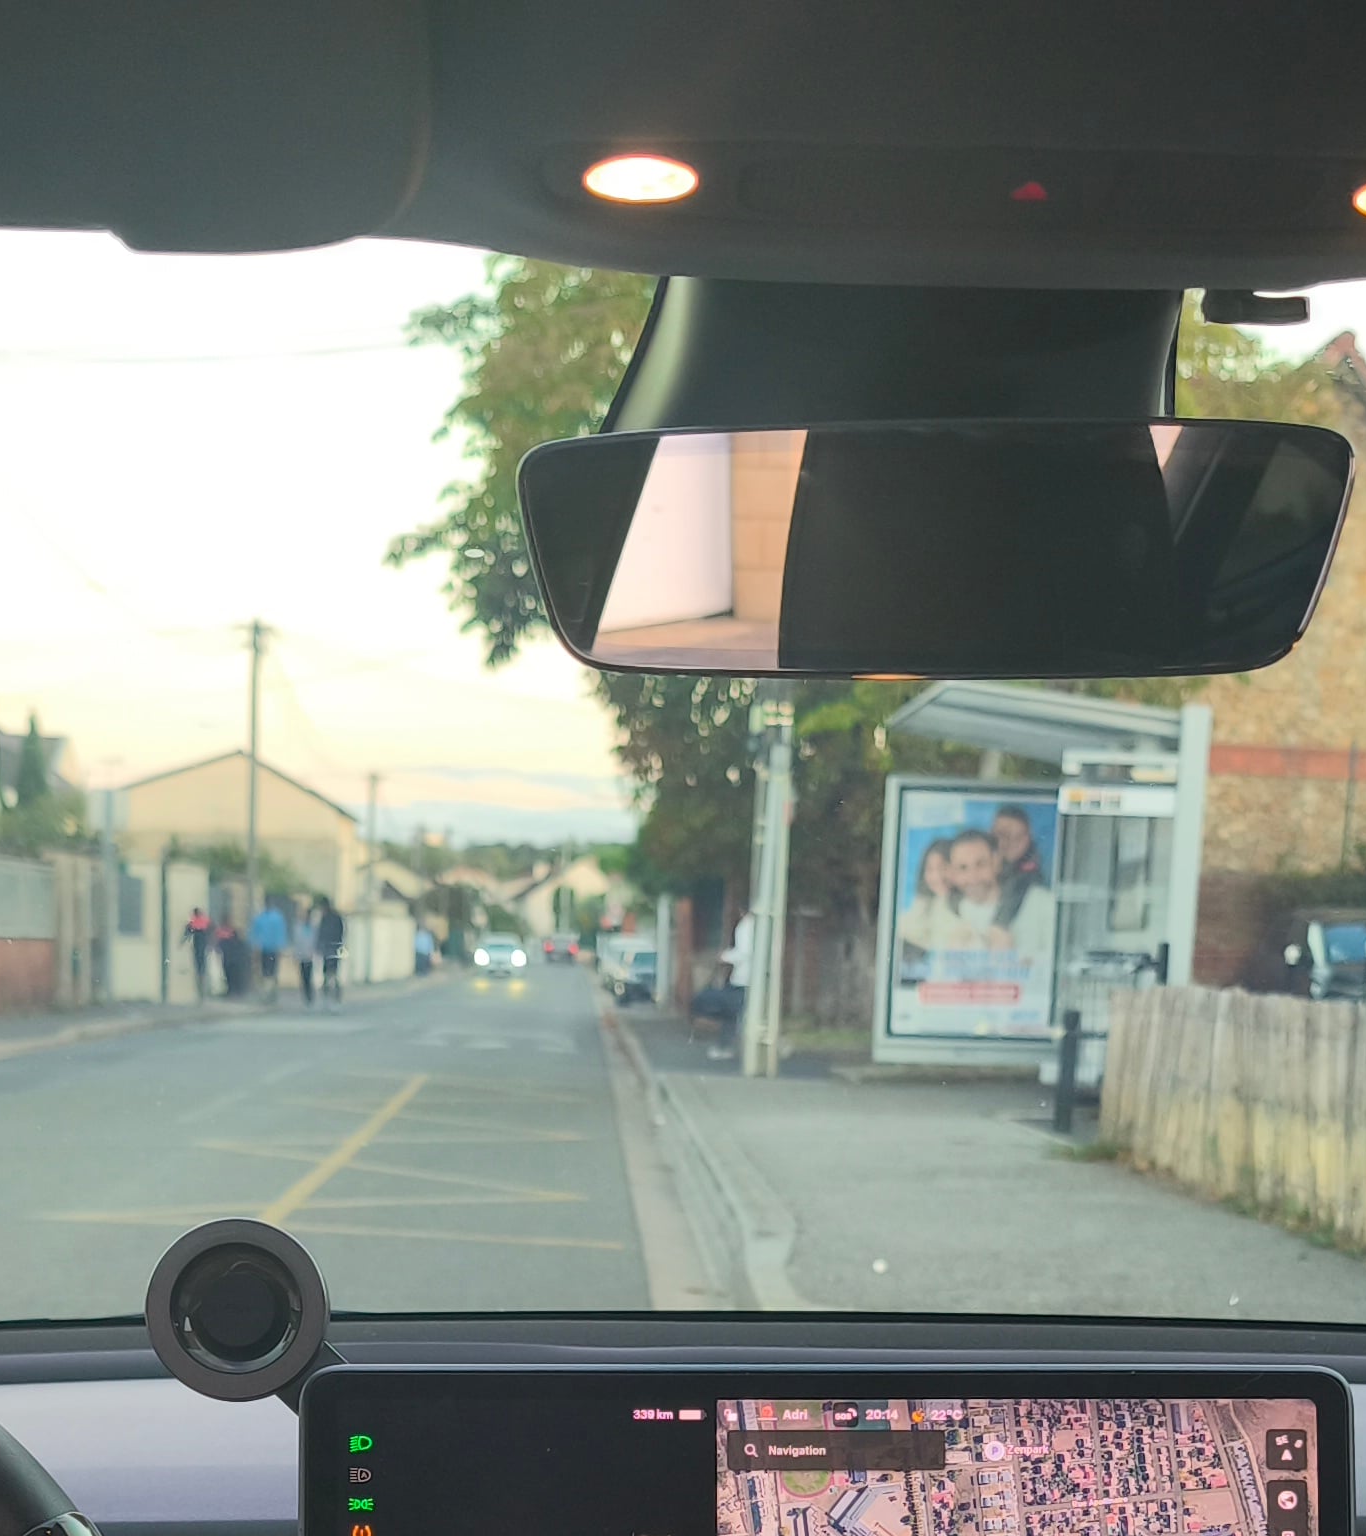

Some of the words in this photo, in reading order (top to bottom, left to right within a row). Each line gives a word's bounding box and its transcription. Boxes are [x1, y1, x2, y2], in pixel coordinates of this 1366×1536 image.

[633, 1409, 654, 1420] 339
[656, 1409, 673, 1420] km
[865, 1409, 899, 1420] 20:14
[930, 1409, 963, 1420] 22°C
[768, 1445, 826, 1457] Navigation
[1006, 1445, 1049, 1457] Zenpark
